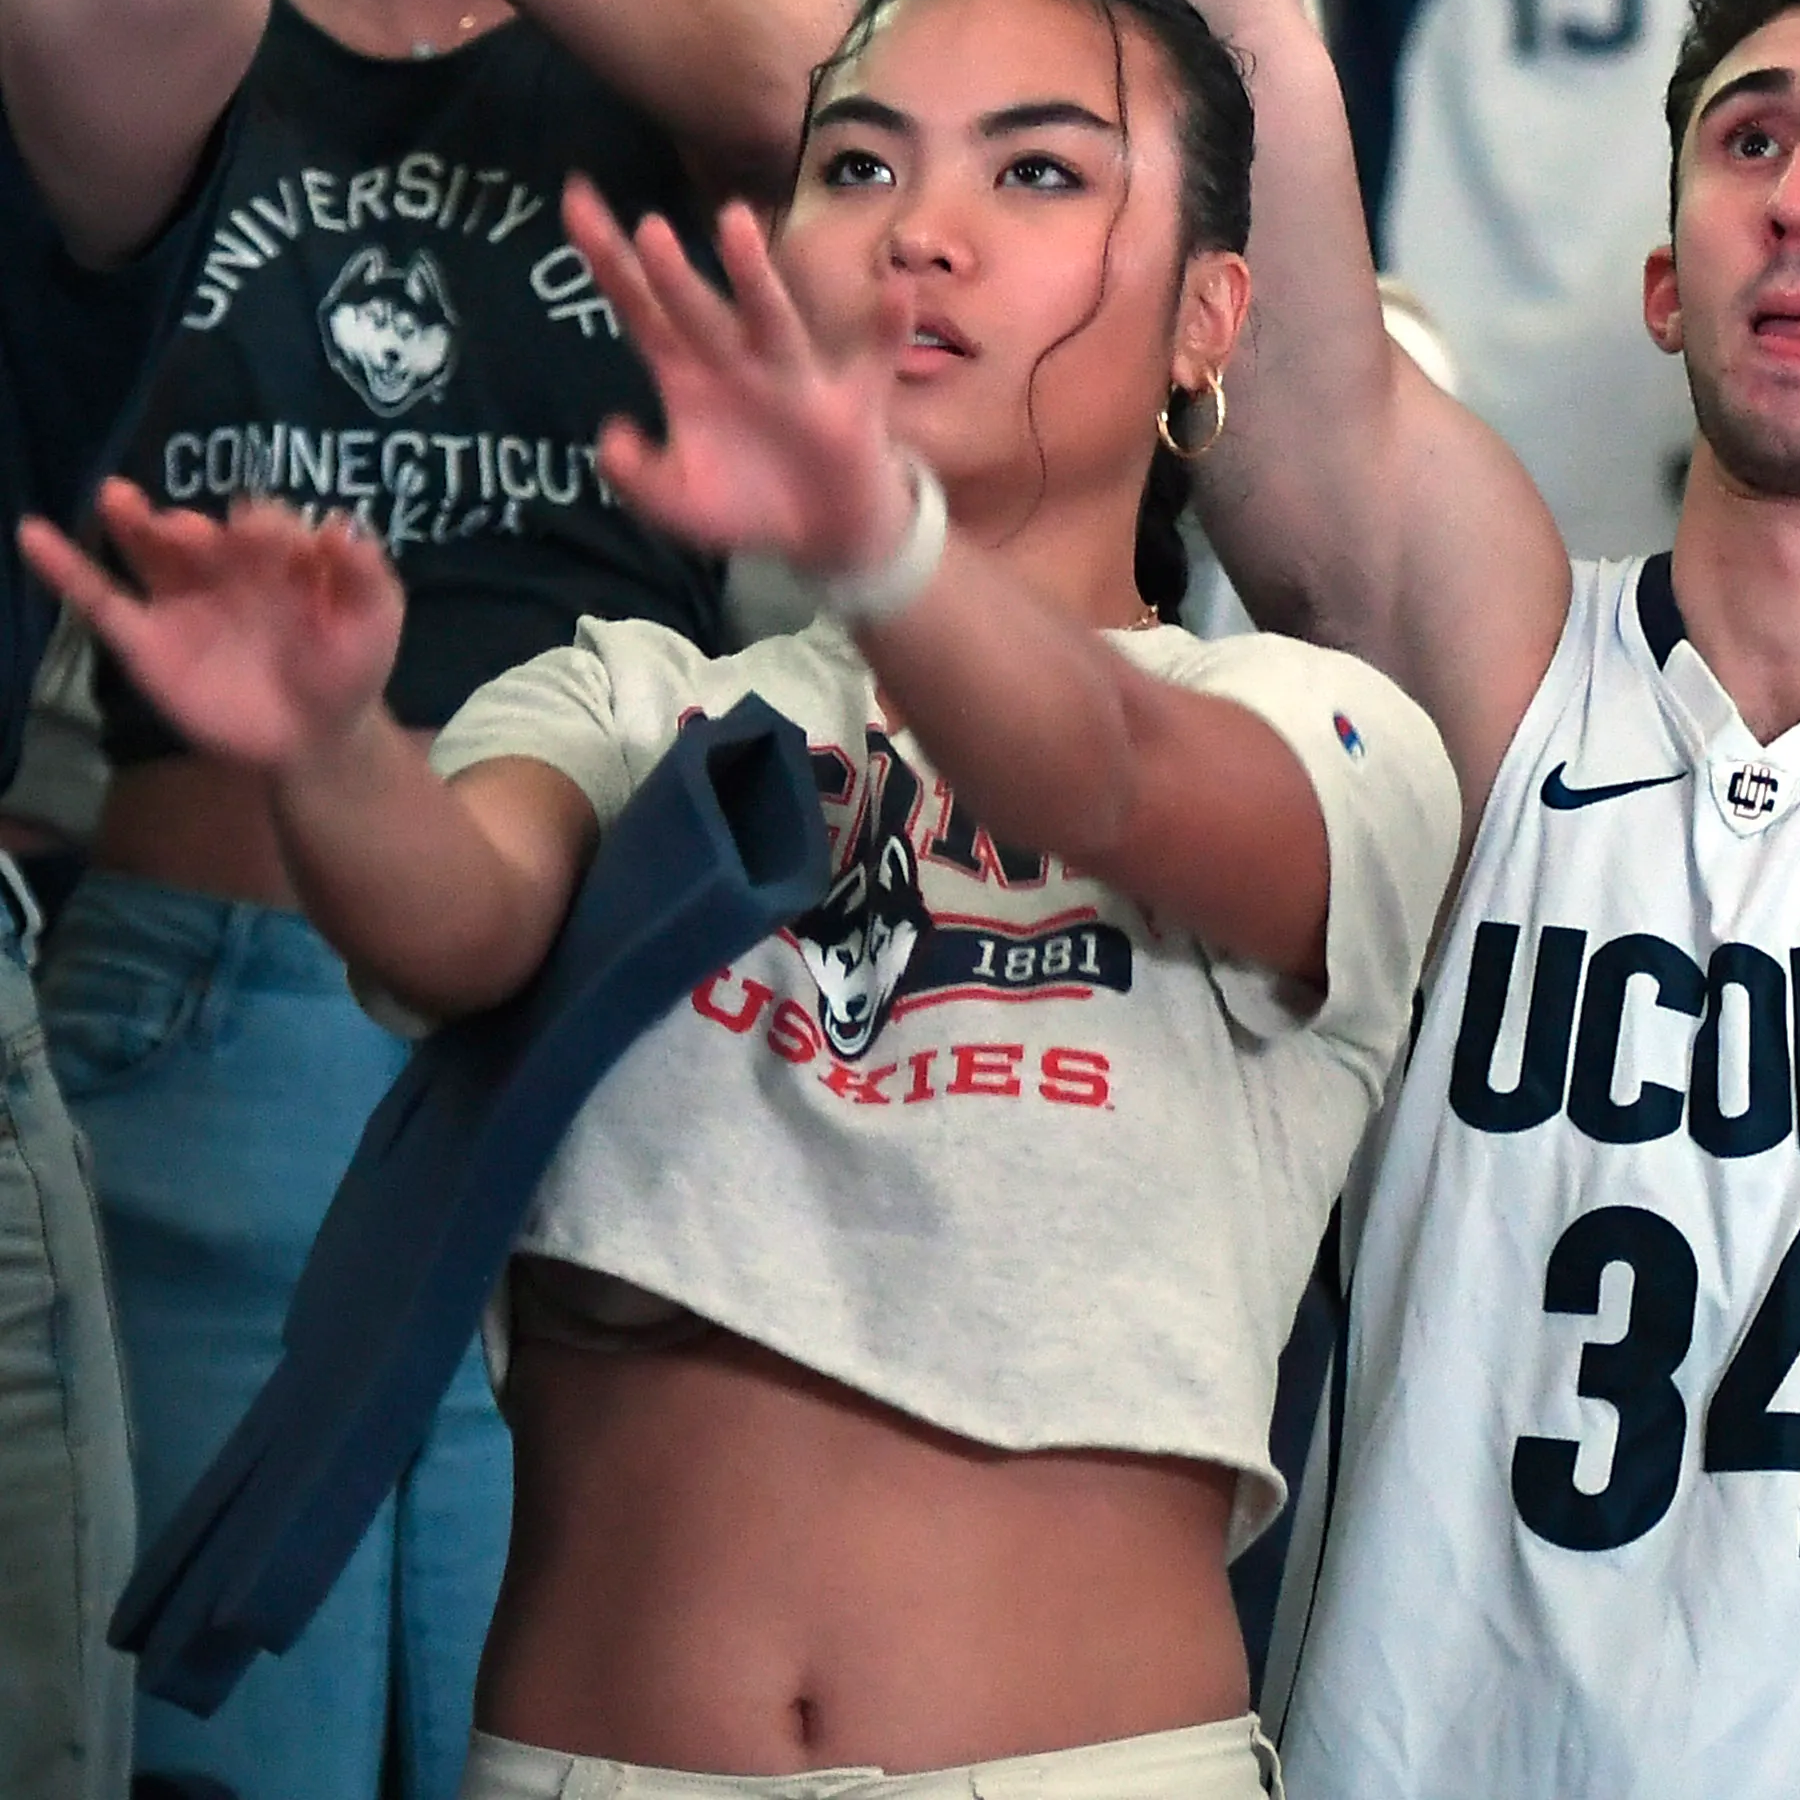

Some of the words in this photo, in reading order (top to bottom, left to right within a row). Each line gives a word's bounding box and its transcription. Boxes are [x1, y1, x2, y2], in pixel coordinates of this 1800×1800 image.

[181, 152, 544, 330] UNIVERSITY
[529, 244, 620, 339] OF
[972, 933, 1102, 982] 1881
[690, 966, 1113, 1107] USKIES
